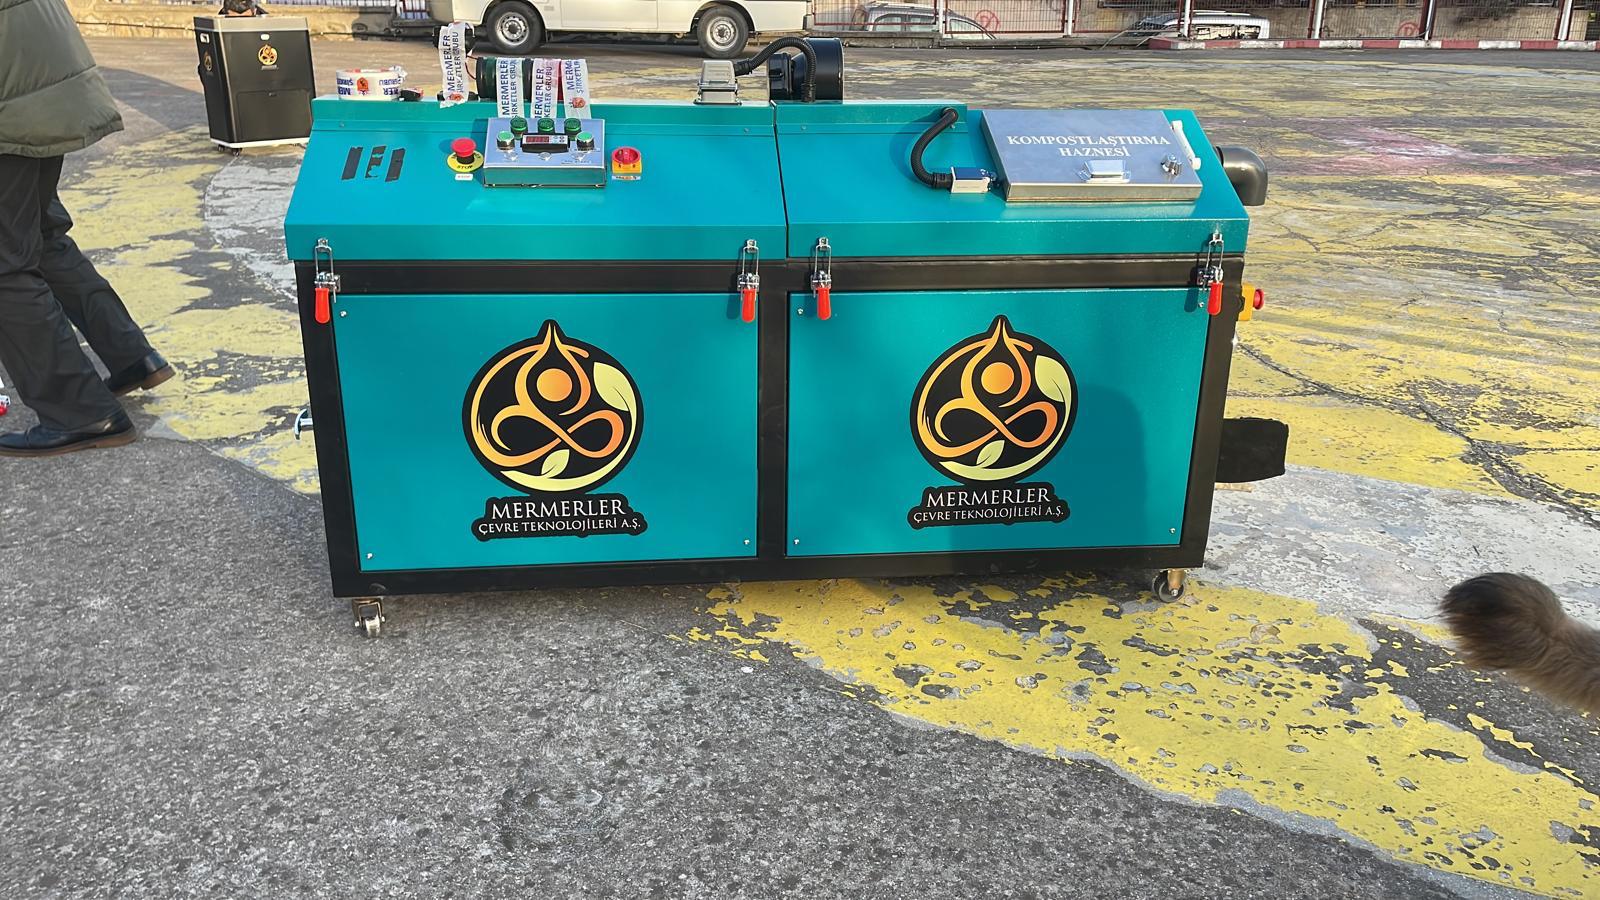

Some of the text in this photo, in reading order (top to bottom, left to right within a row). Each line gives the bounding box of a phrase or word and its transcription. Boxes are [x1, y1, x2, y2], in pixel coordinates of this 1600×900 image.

[500, 60, 510, 116] MERMERLER
[545, 66, 553, 91] GRUBU
[1006, 135, 1171, 148] KOMPOSTLAŞTIRMA
[1058, 146, 1131, 157] HAZNESİ
[926, 487, 1051, 508] MERMERLER
[491, 499, 626, 519] MERMERLER
[913, 504, 1064, 524] ÇEVRE TEKNOLOJİLERİ A.Ş.
[478, 517, 641, 535] ÇEVRE TEKNOLOJİLERİ A.Ş.
